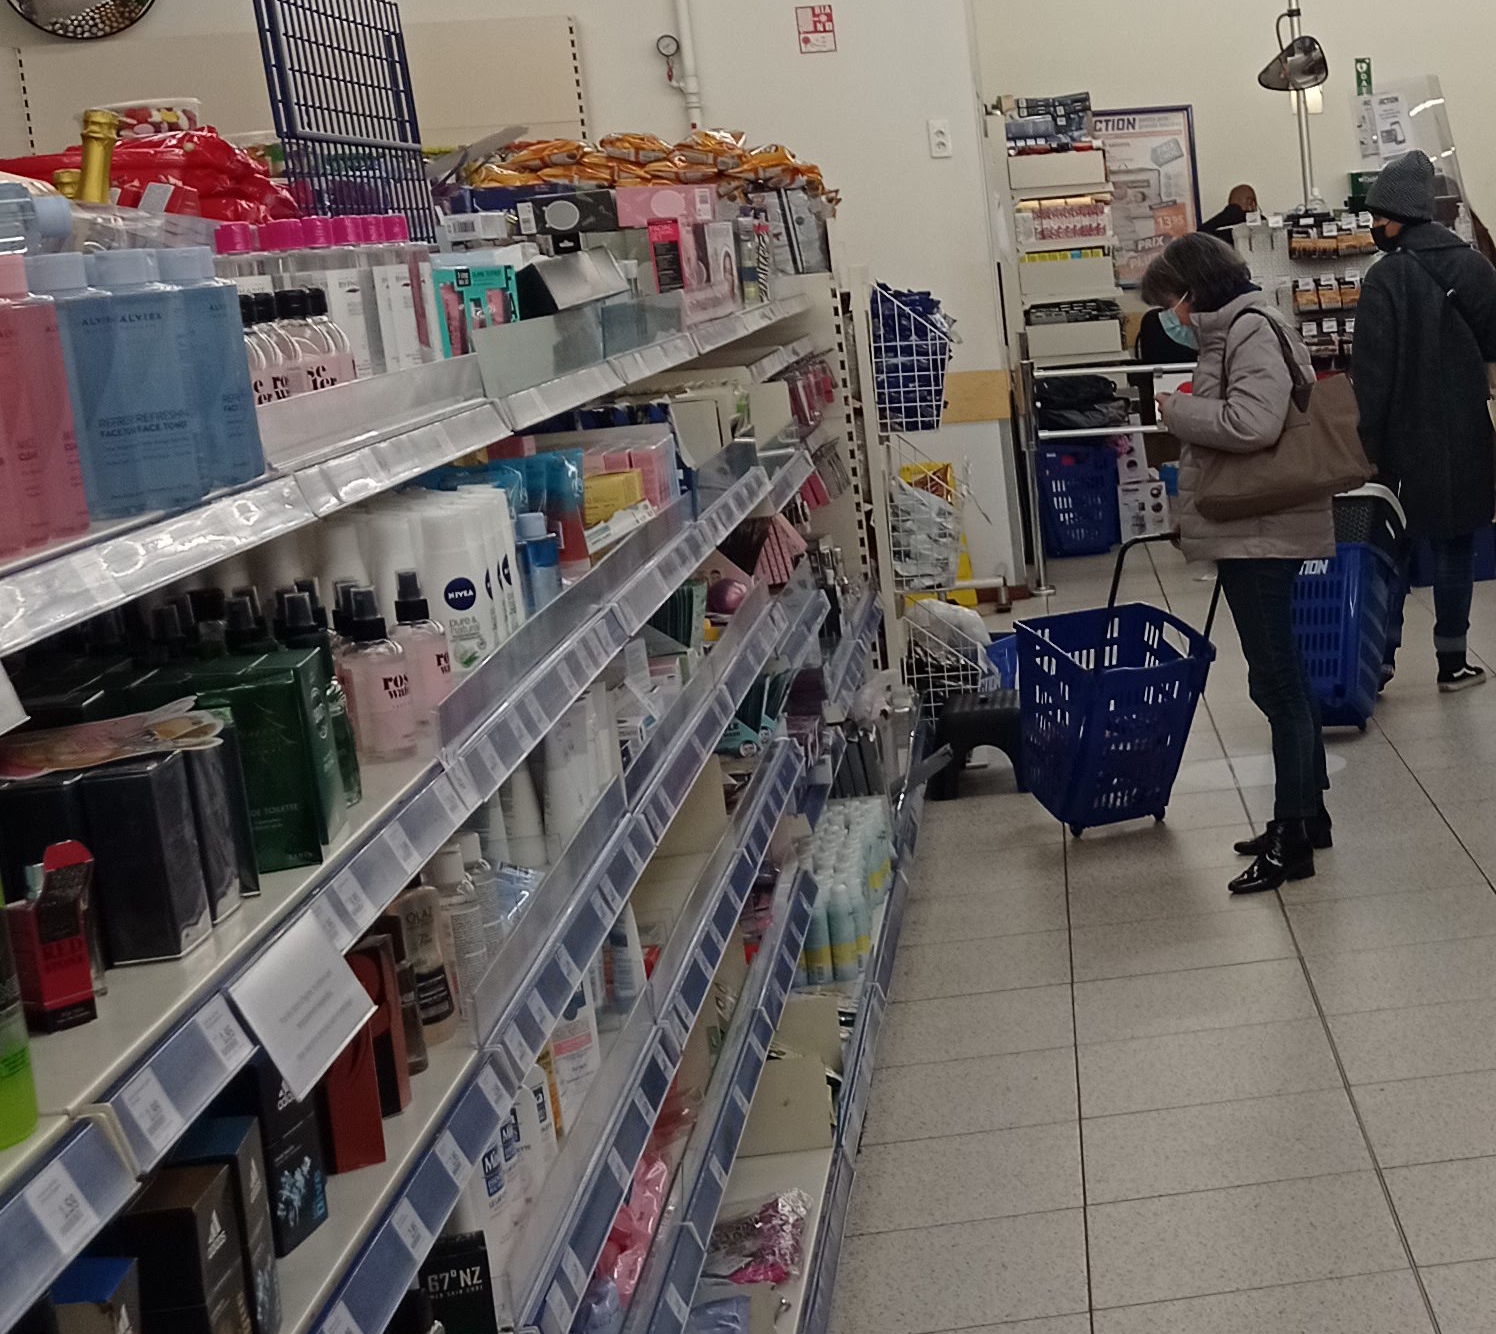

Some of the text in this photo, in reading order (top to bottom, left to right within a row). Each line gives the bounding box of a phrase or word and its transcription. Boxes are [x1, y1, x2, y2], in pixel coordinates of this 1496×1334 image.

[1094, 117, 1136, 132] CTION
[1136, 234, 1165, 251] PRIX
[448, 588, 474, 600] NIVEA
